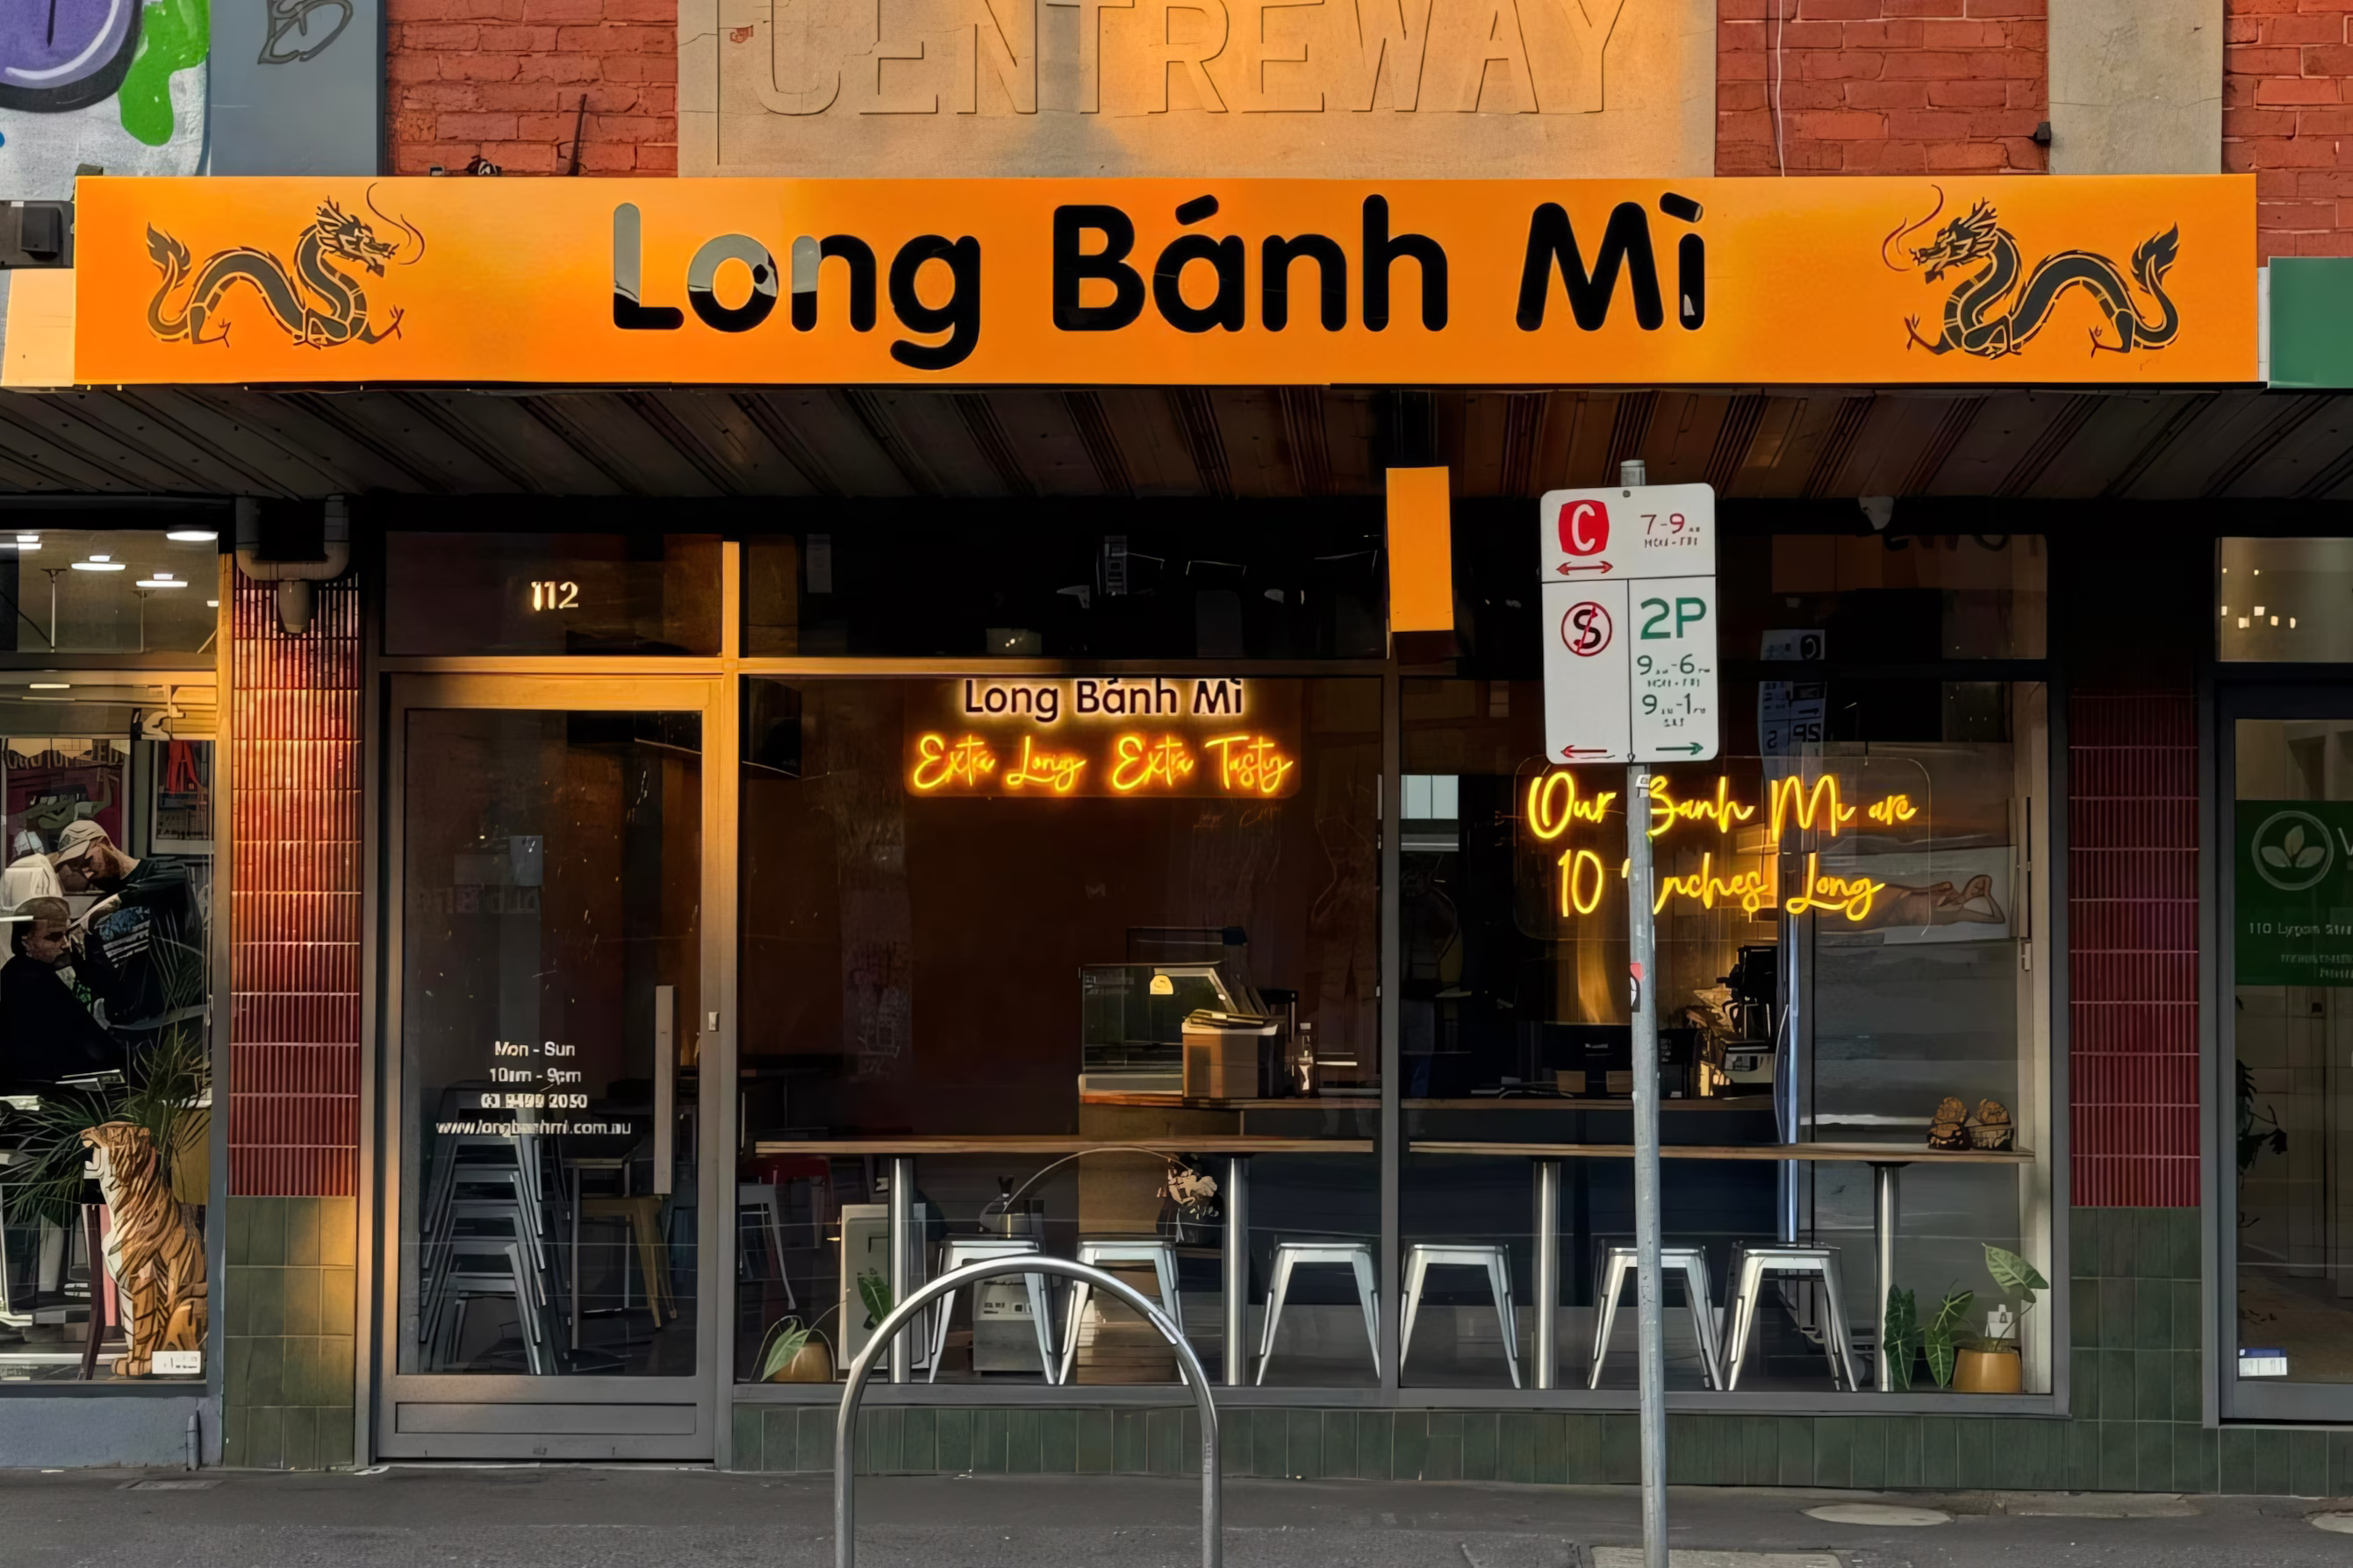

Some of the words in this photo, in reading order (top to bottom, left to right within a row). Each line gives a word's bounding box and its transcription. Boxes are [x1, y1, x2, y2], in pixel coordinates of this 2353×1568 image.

[613, 203, 980, 370] Long
[1053, 195, 1447, 333] Bánh
[1517, 192, 1704, 331] Mì
[531, 581, 579, 612] 112
[1640, 597, 1706, 640] 2P
[965, 679, 1058, 723] Long
[1076, 678, 1178, 714] Bánh
[1193, 679, 1242, 714] Mì
[914, 734, 995, 790] Extra
[1007, 735, 1087, 791] Long
[1112, 734, 1194, 791] Extra
[1204, 735, 1294, 793] Tasty
[1528, 771, 1616, 839] Our
[1869, 793, 1919, 826] are
[1558, 848, 1603, 918] 10
[1622, 851, 1768, 914] nches
[1785, 852, 1886, 921] Long
[2249, 923, 2271, 934] 110
[495, 1042, 528, 1056] Mon
[544, 1042, 575, 1056] Sun
